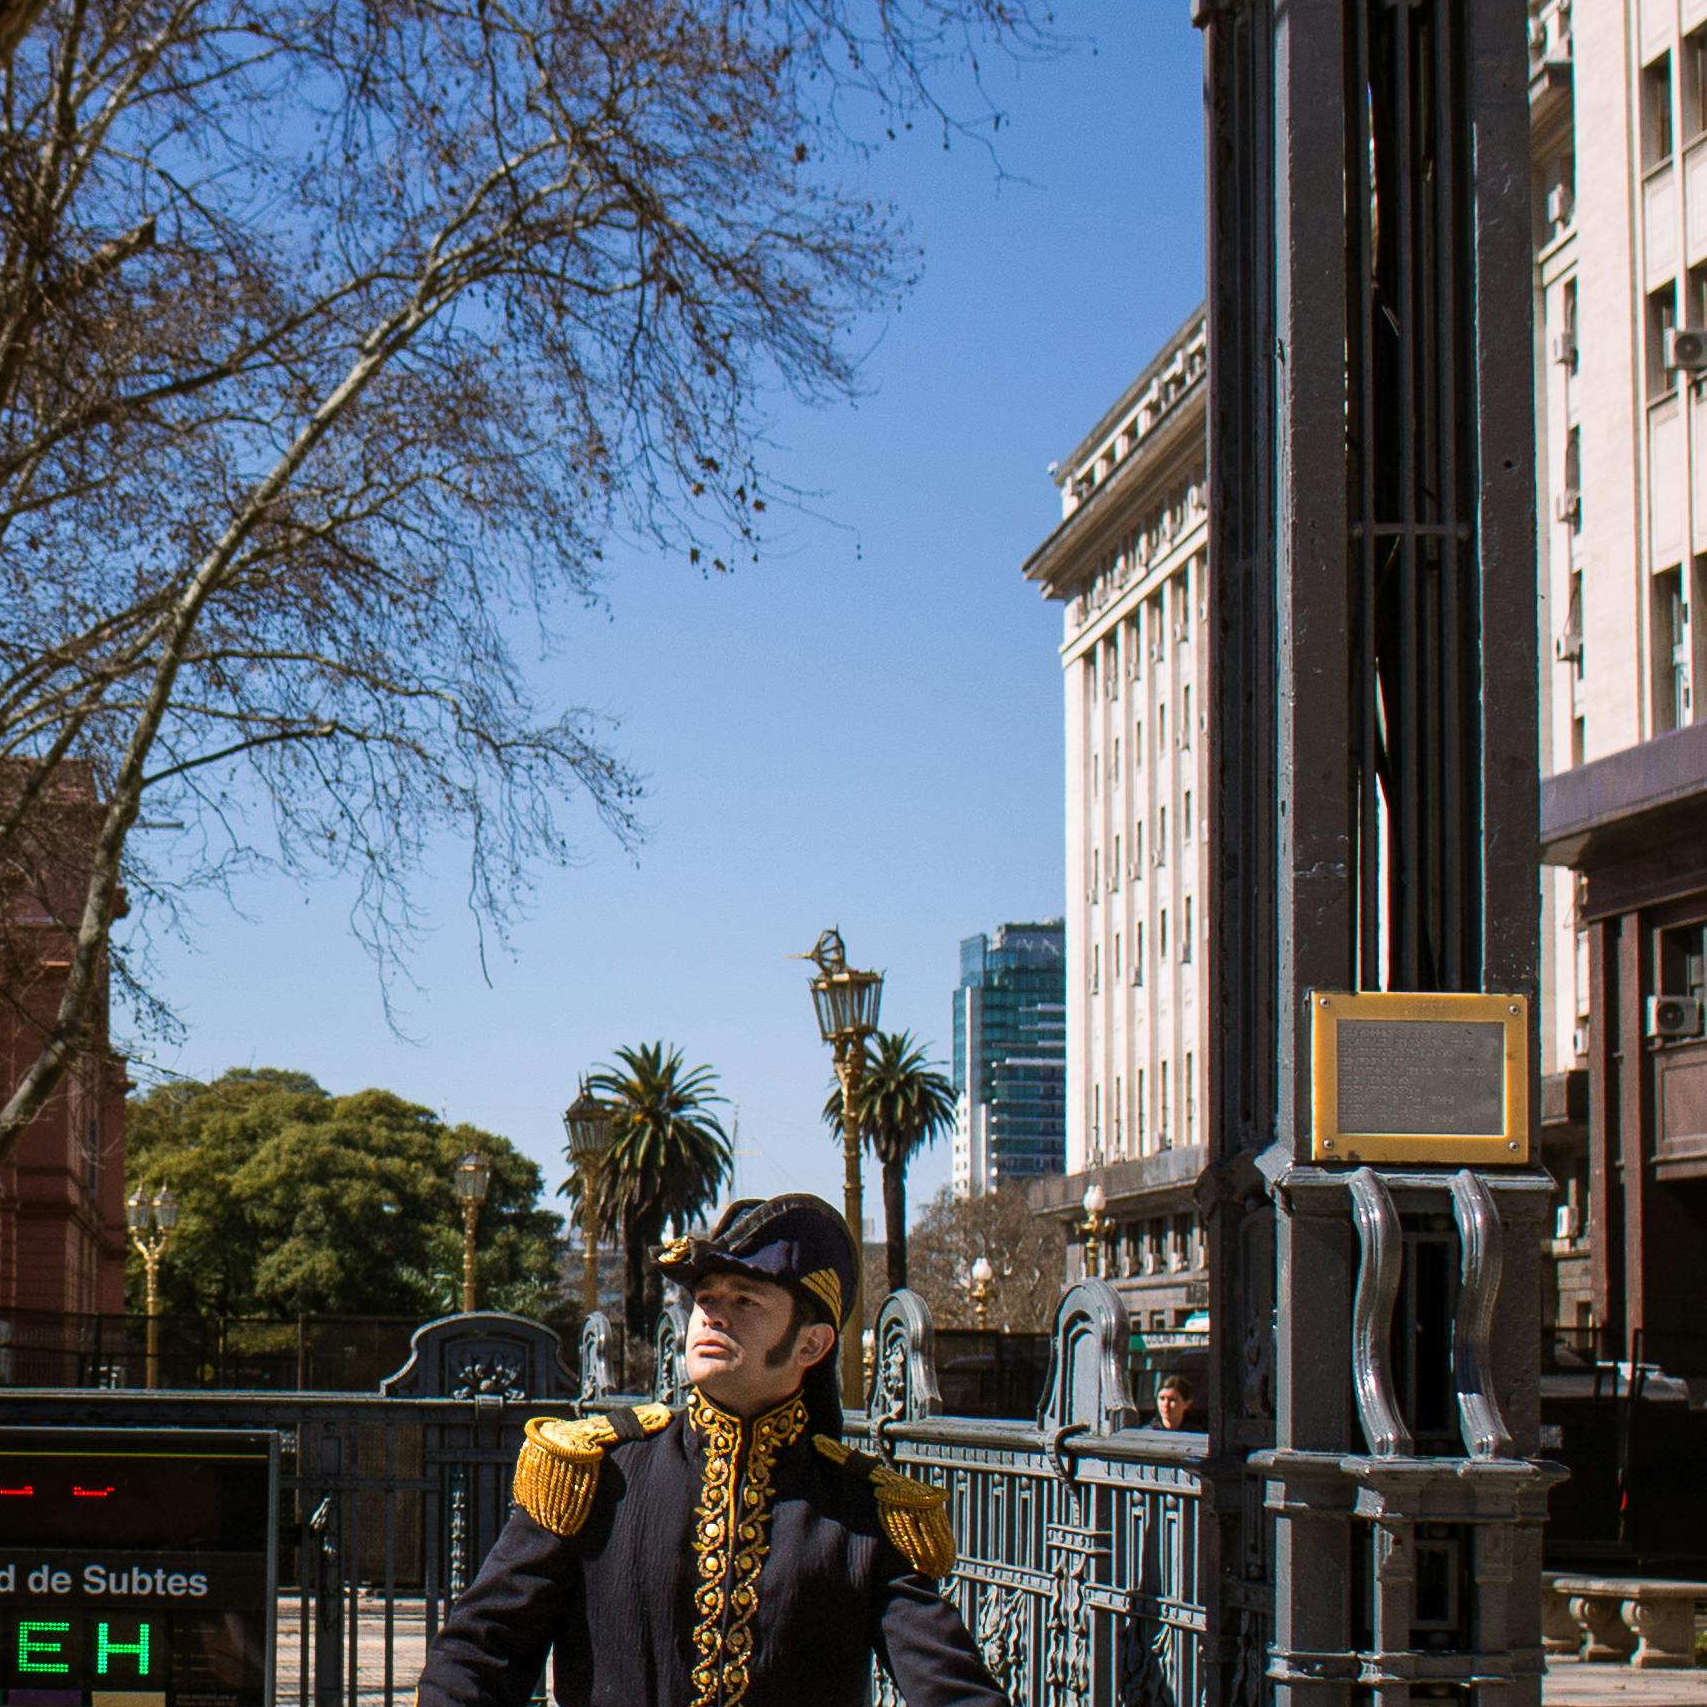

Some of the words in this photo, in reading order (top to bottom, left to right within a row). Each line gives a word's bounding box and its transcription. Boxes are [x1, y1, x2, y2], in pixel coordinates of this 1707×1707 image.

[27, 1564, 73, 1594] de
[82, 1563, 209, 1597] Subtes
[18, 1621, 70, 1673] E
[98, 1622, 150, 1675] H
